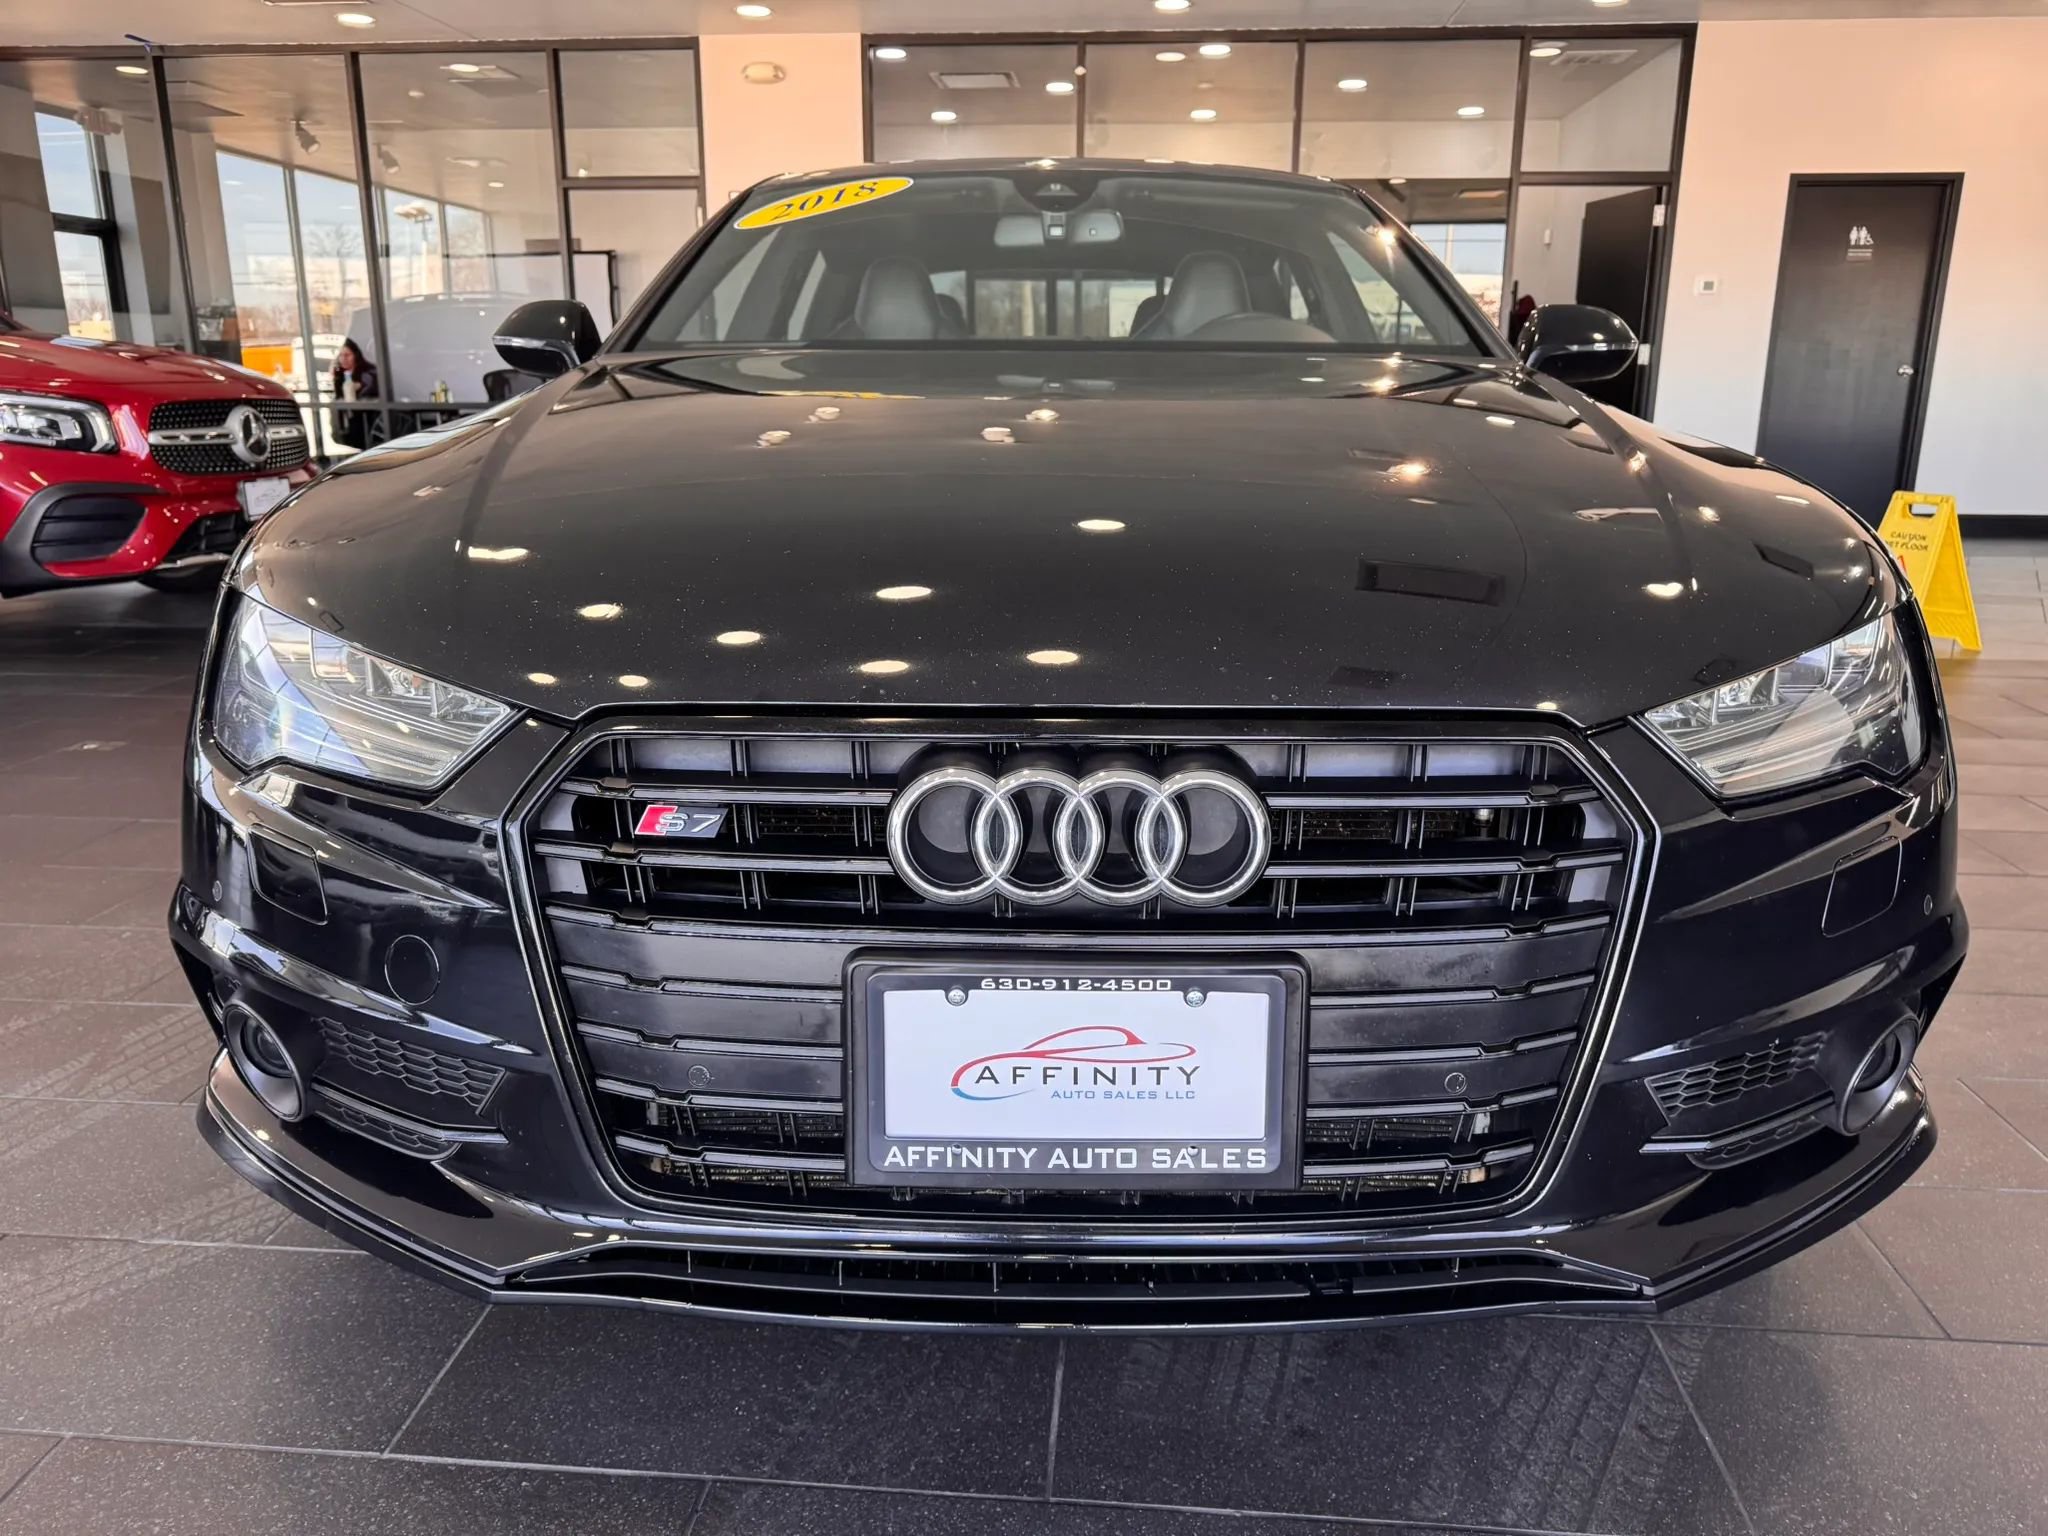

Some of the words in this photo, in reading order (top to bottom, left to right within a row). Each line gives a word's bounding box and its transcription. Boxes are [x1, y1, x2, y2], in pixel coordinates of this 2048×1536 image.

[769, 182, 878, 222] 2018
[655, 812, 720, 832] S7
[980, 977, 1172, 991] 630-912-4500
[974, 1065, 1200, 1086] AFFINITY
[1050, 1090, 1095, 1100] AUTO
[1103, 1090, 1158, 1100] SALES
[1165, 1090, 1196, 1100] LLC
[884, 1146, 1037, 1169] AFFINITY
[1048, 1147, 1137, 1169] AUTO
[1152, 1147, 1267, 1169] SALES
